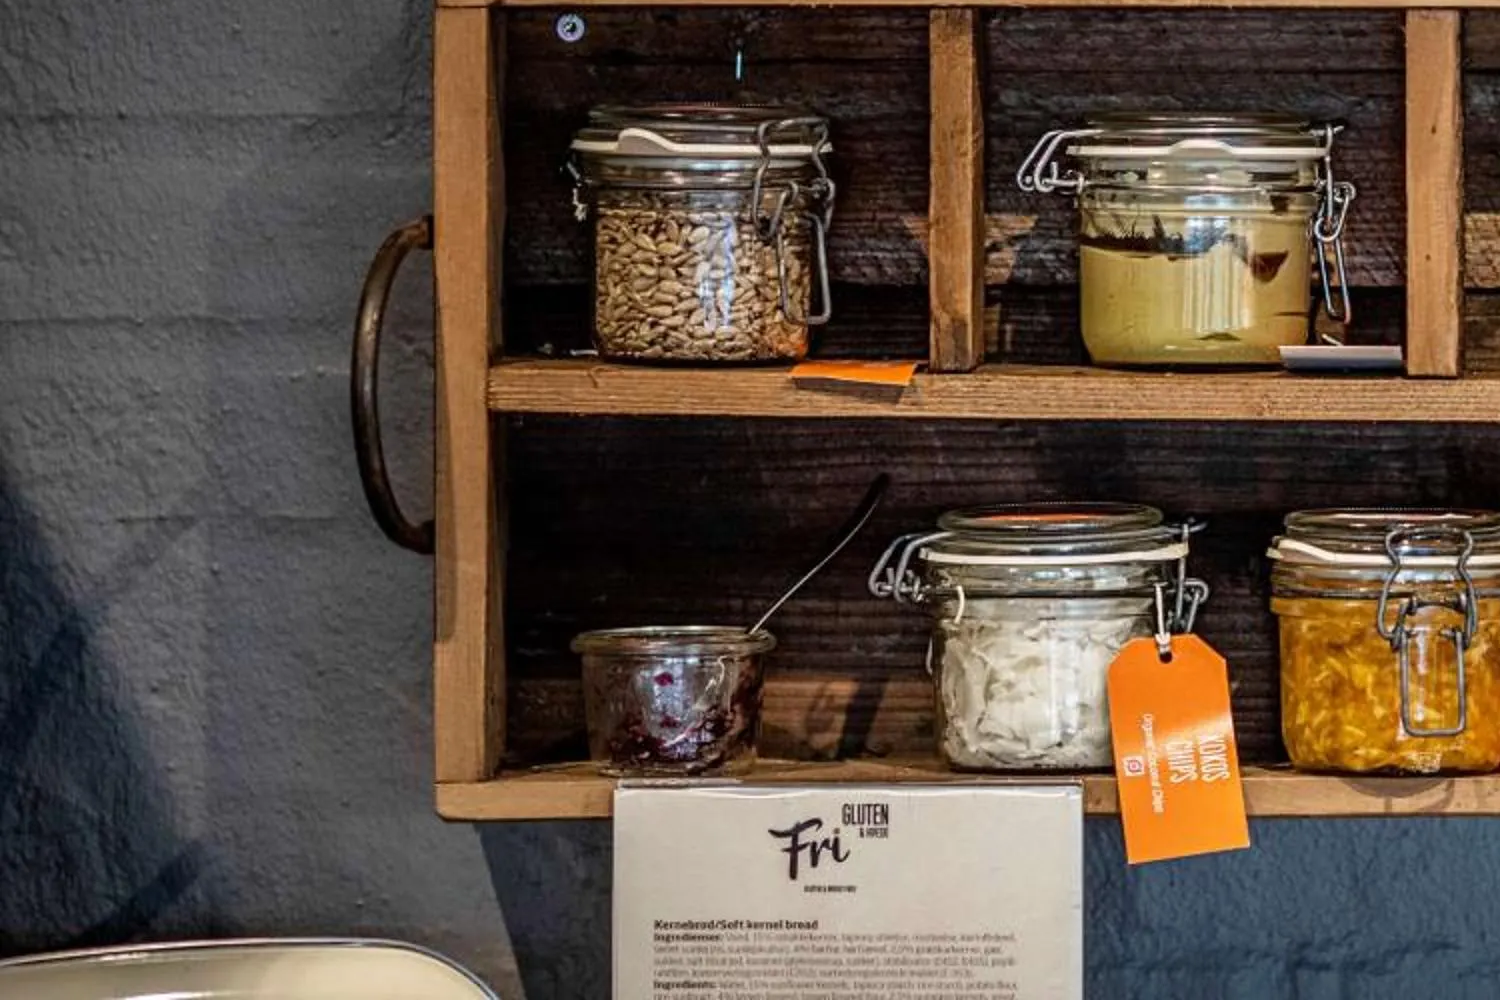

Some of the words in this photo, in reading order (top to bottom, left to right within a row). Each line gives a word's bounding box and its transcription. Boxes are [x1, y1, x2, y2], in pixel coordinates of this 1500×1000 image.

[1166, 740, 1197, 783] CHIPS
[1199, 733, 1230, 782] KOKOS
[841, 803, 889, 826] GLUTEN
[767, 817, 851, 881] Fri
[746, 919, 783, 930] kernel
[785, 919, 819, 930] bread
